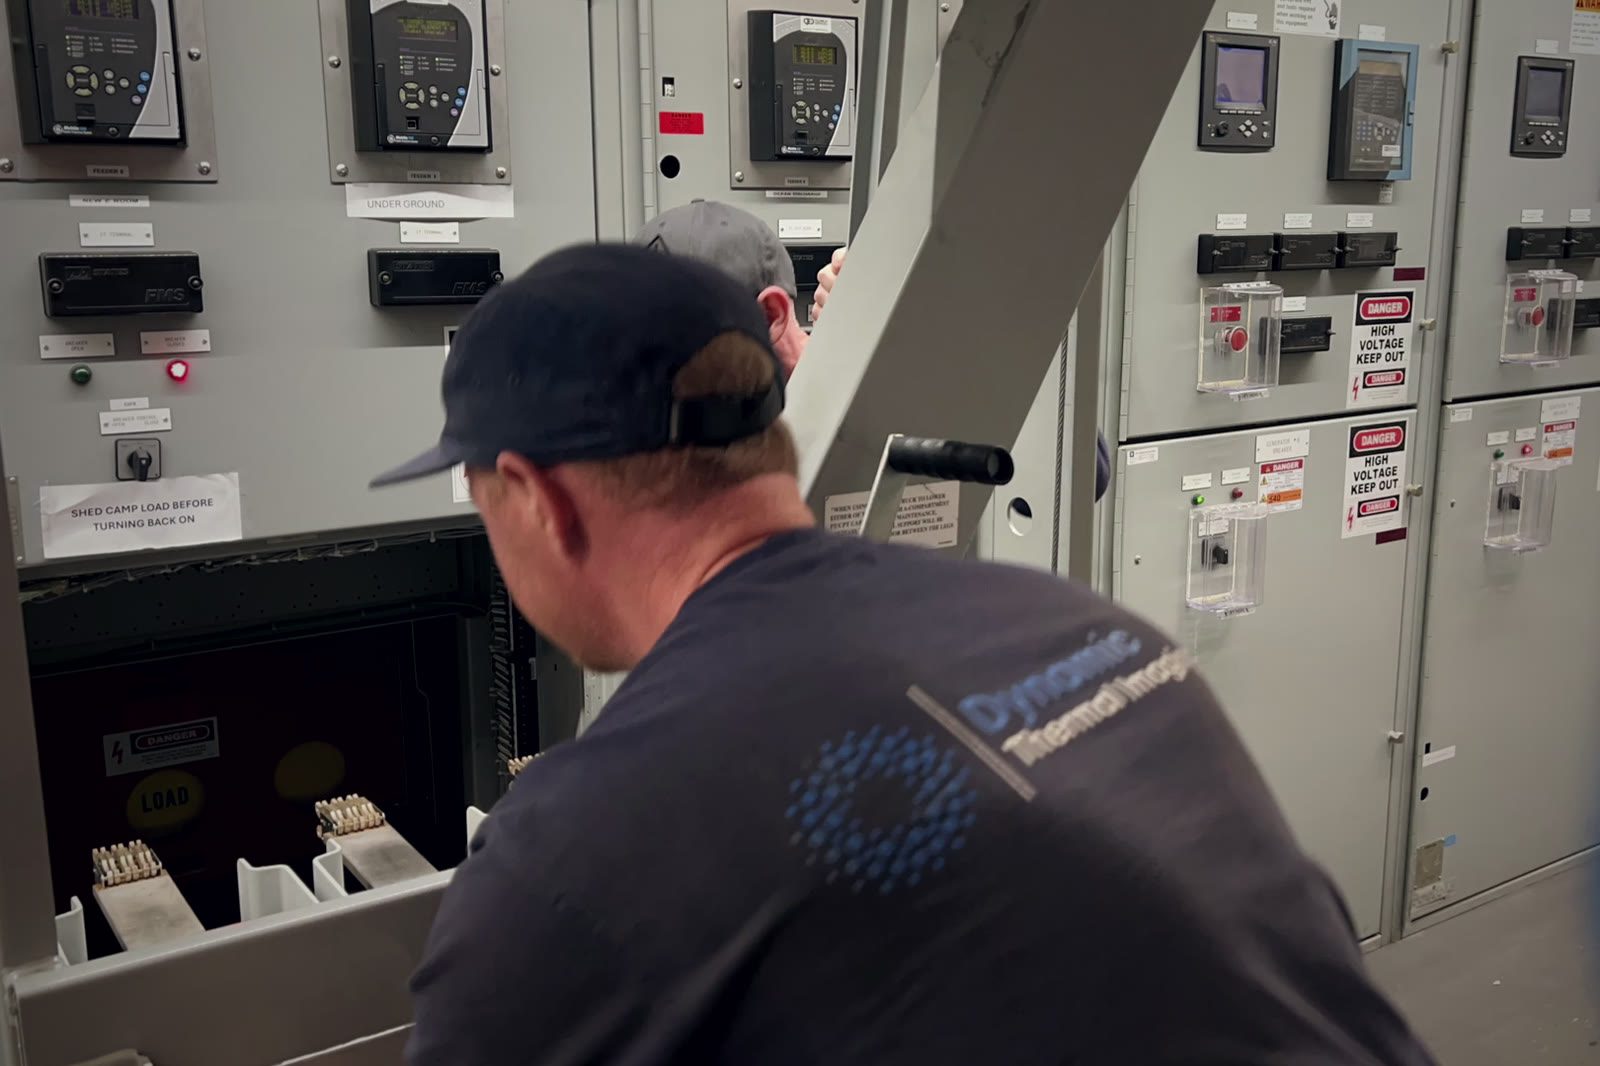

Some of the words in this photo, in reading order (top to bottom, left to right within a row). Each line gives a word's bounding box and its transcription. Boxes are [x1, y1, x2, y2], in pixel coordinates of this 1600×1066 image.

[367, 200, 401, 209] UNDER
[403, 200, 445, 209] GROUND
[144, 287, 186, 303] FMS
[1368, 302, 1403, 315] DANGER
[1371, 325, 1395, 337] HIGH
[1359, 337, 1404, 351] VOLTAGE
[1356, 353, 1382, 365] KEEP
[1385, 351, 1405, 362] OUT
[1371, 373, 1397, 384] DANGER
[1361, 432, 1397, 446] DANGER
[1272, 461, 1299, 471] DANGER
[1365, 455, 1389, 467] HIGH
[1353, 466, 1398, 481] VOLTAGE
[1350, 482, 1376, 495] KEEP
[1379, 478, 1399, 491] OUT
[71, 507, 103, 518] SHED
[105, 504, 138, 515] CAMP
[141, 501, 170, 513] LOAD
[172, 498, 214, 510] BEFORE
[1366, 500, 1391, 512] DANGER
[93, 519, 145, 531] TURNING
[147, 516, 177, 527] BACK
[178, 514, 196, 524] ON
[147, 729, 197, 746] DANGER
[141, 786, 190, 813] LOAD
